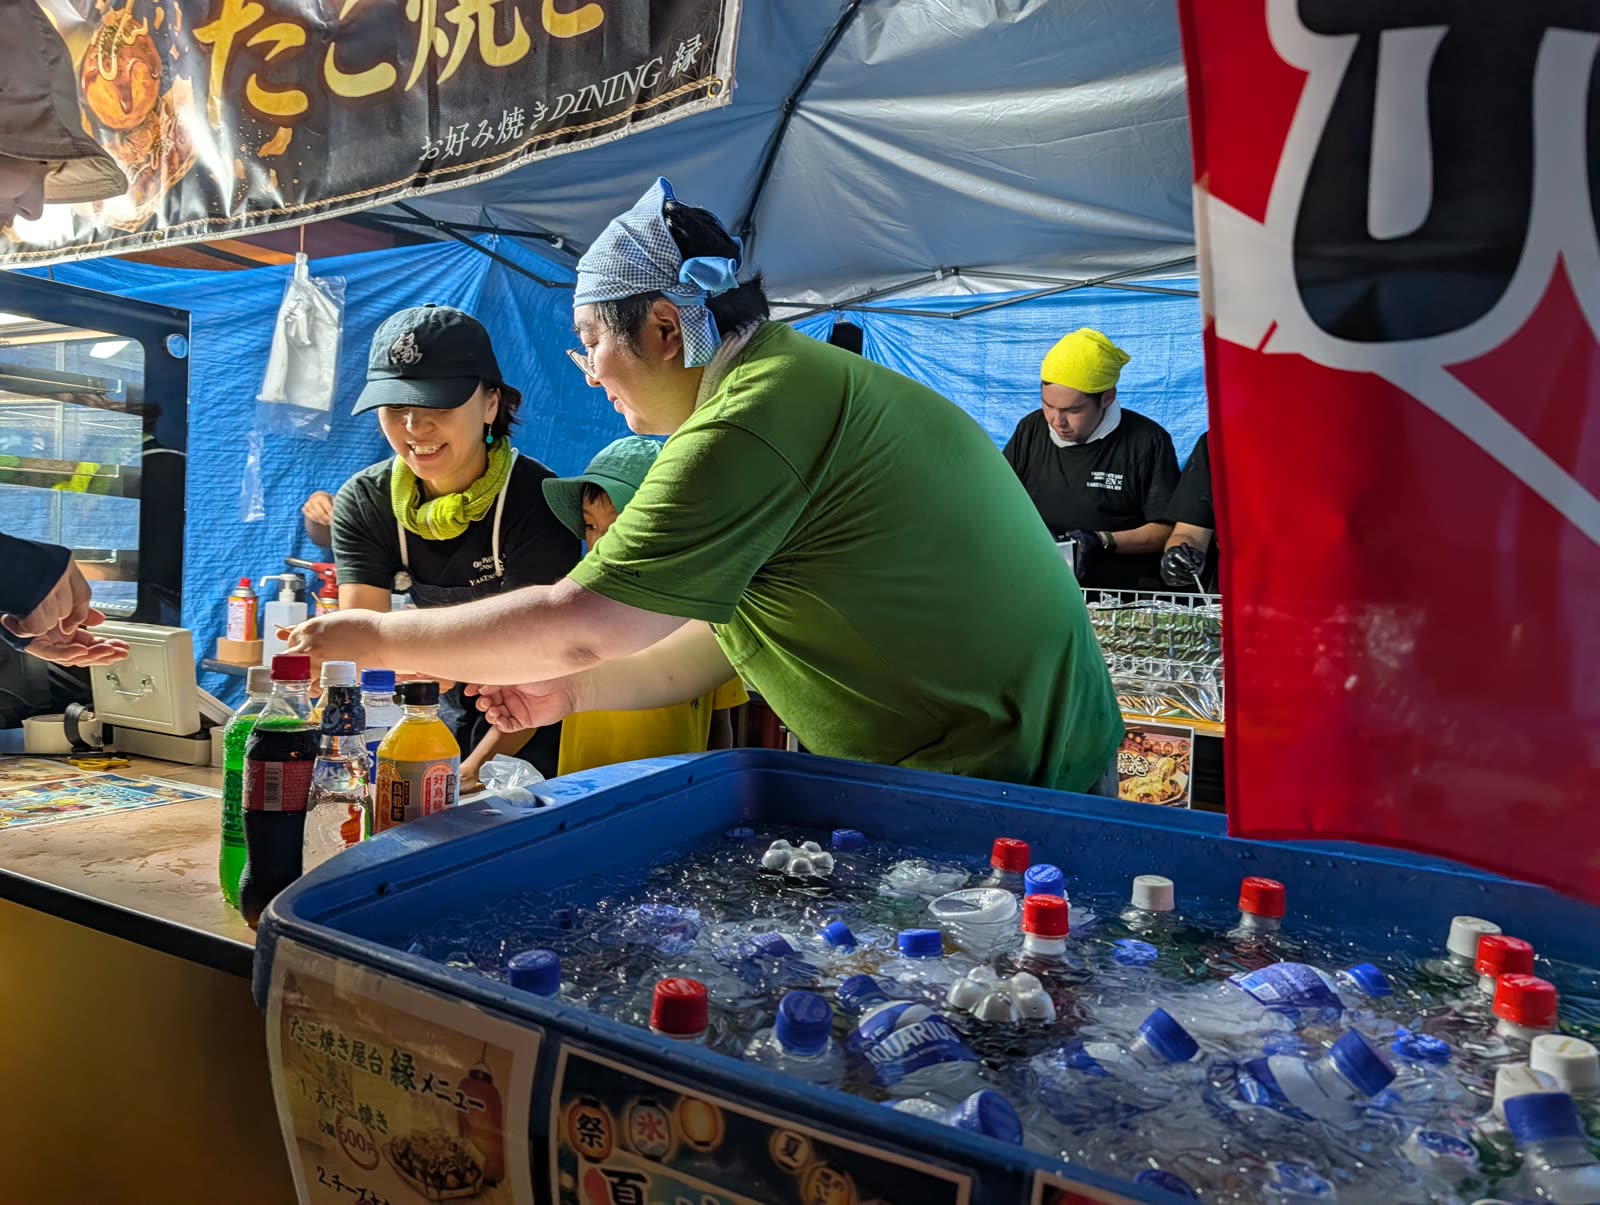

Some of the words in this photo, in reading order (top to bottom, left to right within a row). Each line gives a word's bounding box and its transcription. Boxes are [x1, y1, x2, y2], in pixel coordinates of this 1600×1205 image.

[193, 0, 605, 128] たこ焼
[864, 1021, 960, 1065] AQUARIUS
[577, 1113, 606, 1149] 祭
